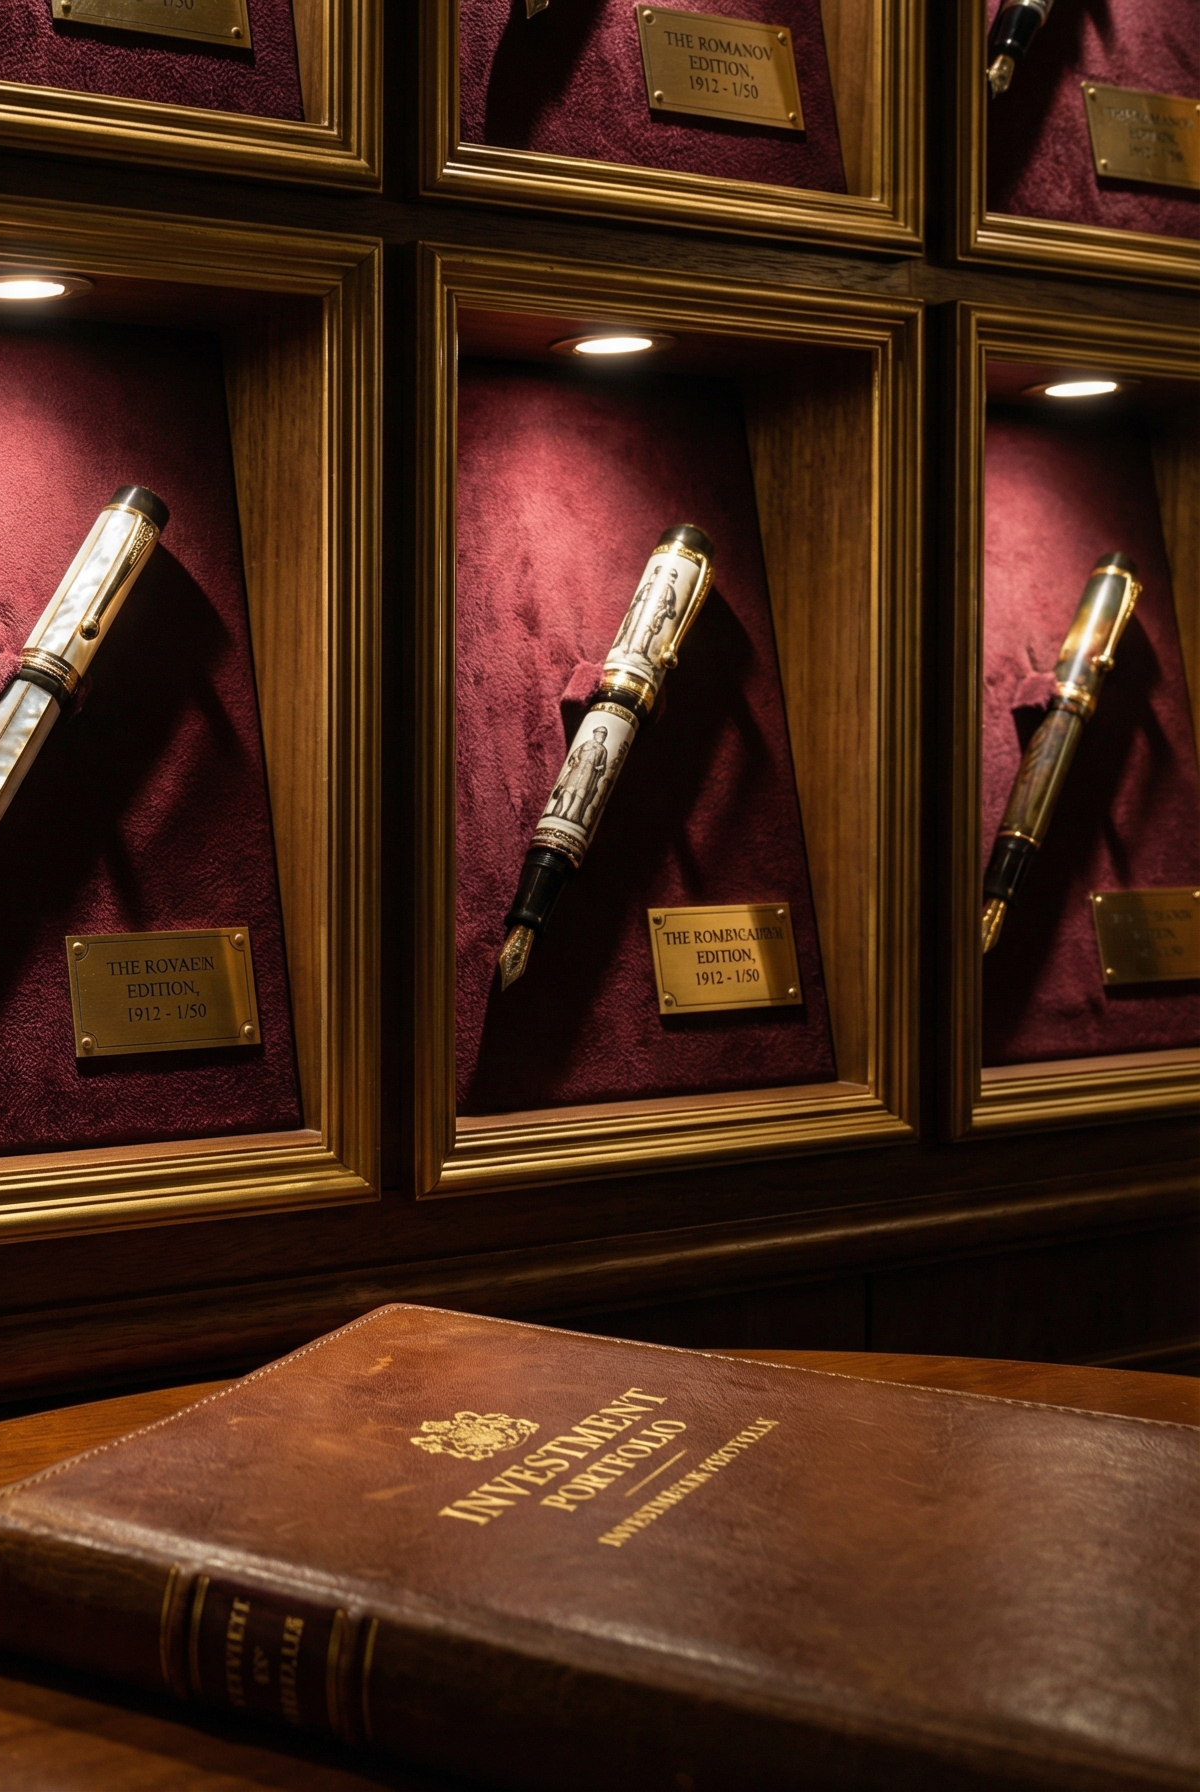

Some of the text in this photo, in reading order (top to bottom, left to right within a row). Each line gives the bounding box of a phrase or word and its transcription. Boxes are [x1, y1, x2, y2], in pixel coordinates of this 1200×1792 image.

[664, 30, 774, 61] THE ROMANOV
[689, 75, 720, 94] 1912
[732, 82, 759, 99] 1/50
[663, 931, 691, 946] THE
[696, 948, 756, 964] EDITION,
[106, 960, 141, 976] THE
[695, 970, 724, 986] 1912
[735, 968, 760, 983] 1/50
[126, 980, 200, 998] EDITION,
[177, 1003, 207, 1019] 1/50
[437, 1386, 668, 1526] INVESTMENT
[539, 1419, 687, 1512] PORTFOLIO
